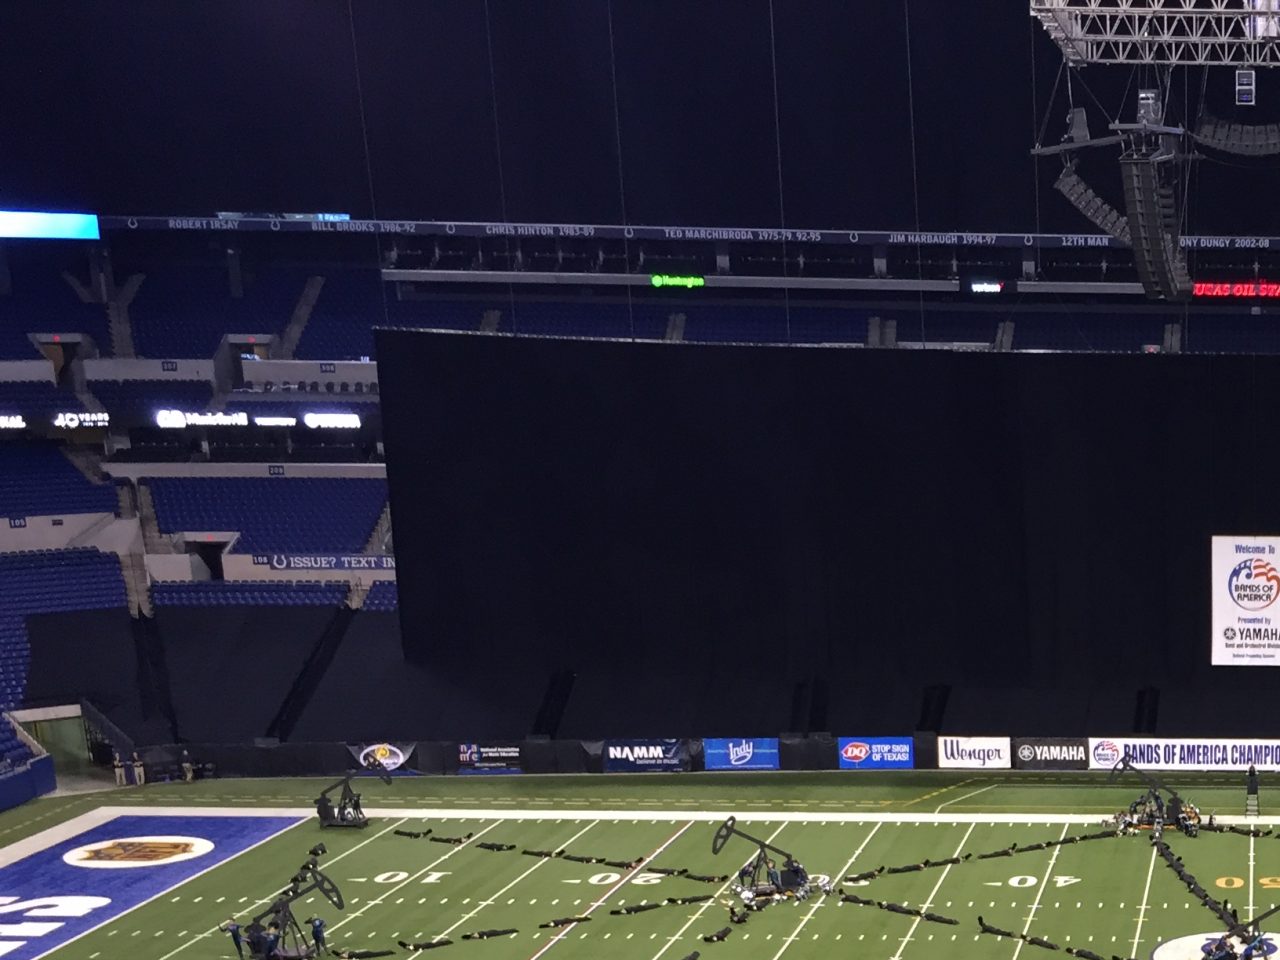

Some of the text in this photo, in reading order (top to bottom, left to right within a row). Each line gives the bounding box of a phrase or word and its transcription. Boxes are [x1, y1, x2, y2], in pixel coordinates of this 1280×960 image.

[169, 220, 239, 230] ROBERT IRSAY
[312, 222, 334, 231] BILL
[337, 223, 375, 232] BROOKS
[486, 225, 595, 236] CHRIS HINTON 1983-89
[664, 229, 683, 238] TED
[685, 229, 753, 240] MARCHIBRODA
[796, 232, 821, 242] 92-95
[888, 234, 997, 245] JIM HARBAUGH 1994-97
[1061, 236, 1109, 246] 12TH MAN
[1180, 238, 1270, 248] ONY DUNGY 2002-08
[1193, 284, 1230, 297] UCAS
[1234, 284, 1257, 296] OIL
[1235, 544, 1275, 554] Welcome To
[289, 556, 337, 568] ISSUE?
[341, 557, 377, 568] TEXT
[1234, 584, 1274, 593] BANDS OF
[1237, 593, 1271, 602] AMERICA
[1264, 617, 1271, 625] by
[609, 746, 663, 761] NAMM
[728, 740, 753, 765] Indy
[847, 745, 868, 758] DQ
[892, 744, 909, 752] SIGN
[943, 739, 1003, 766] Wenger
[1034, 746, 1086, 761] YAMAHA
[872, 753, 909, 761] OF TEXAS!
[1124, 743, 1160, 764] BANDS
[1164, 744, 1177, 764] OF
[1179, 744, 1228, 765] AMERICA
